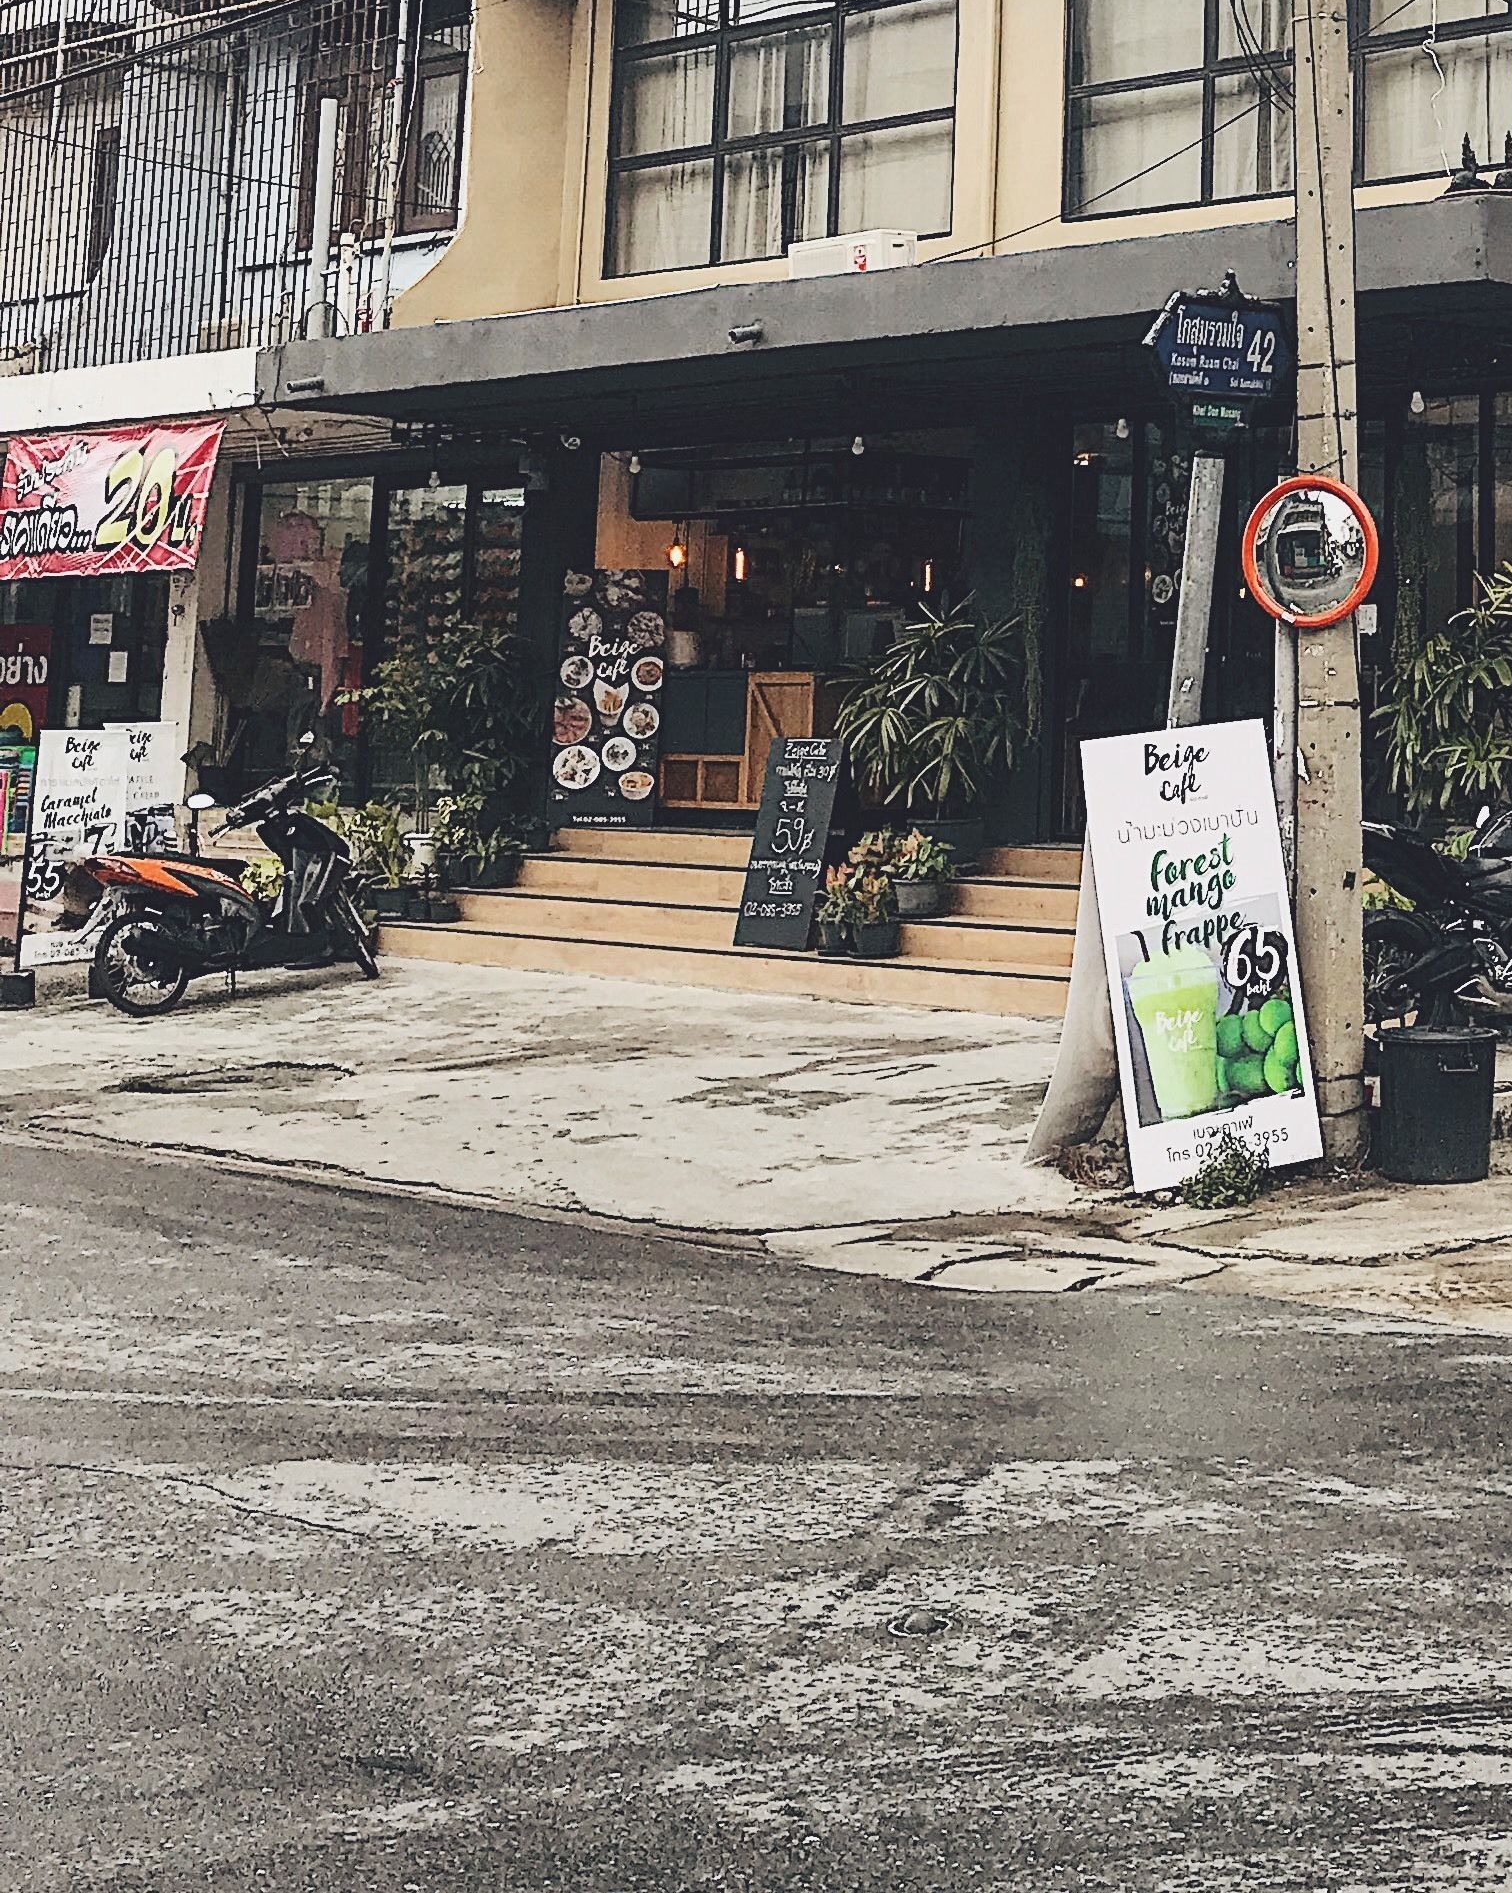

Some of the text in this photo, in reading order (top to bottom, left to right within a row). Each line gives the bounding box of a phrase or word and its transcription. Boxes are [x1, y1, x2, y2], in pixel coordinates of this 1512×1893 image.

[1246, 329, 1276, 373] 42
[95, 448, 177, 548] 20
[588, 634, 643, 661] Beige
[65, 736, 102, 758] Beige
[1143, 743, 1211, 776] Beige
[41, 786, 98, 813] Caramel
[26, 860, 66, 893] 55
[1146, 868, 1237, 921] mango
[1225, 926, 1281, 988] 65
[1246, 979, 1272, 997] baht
